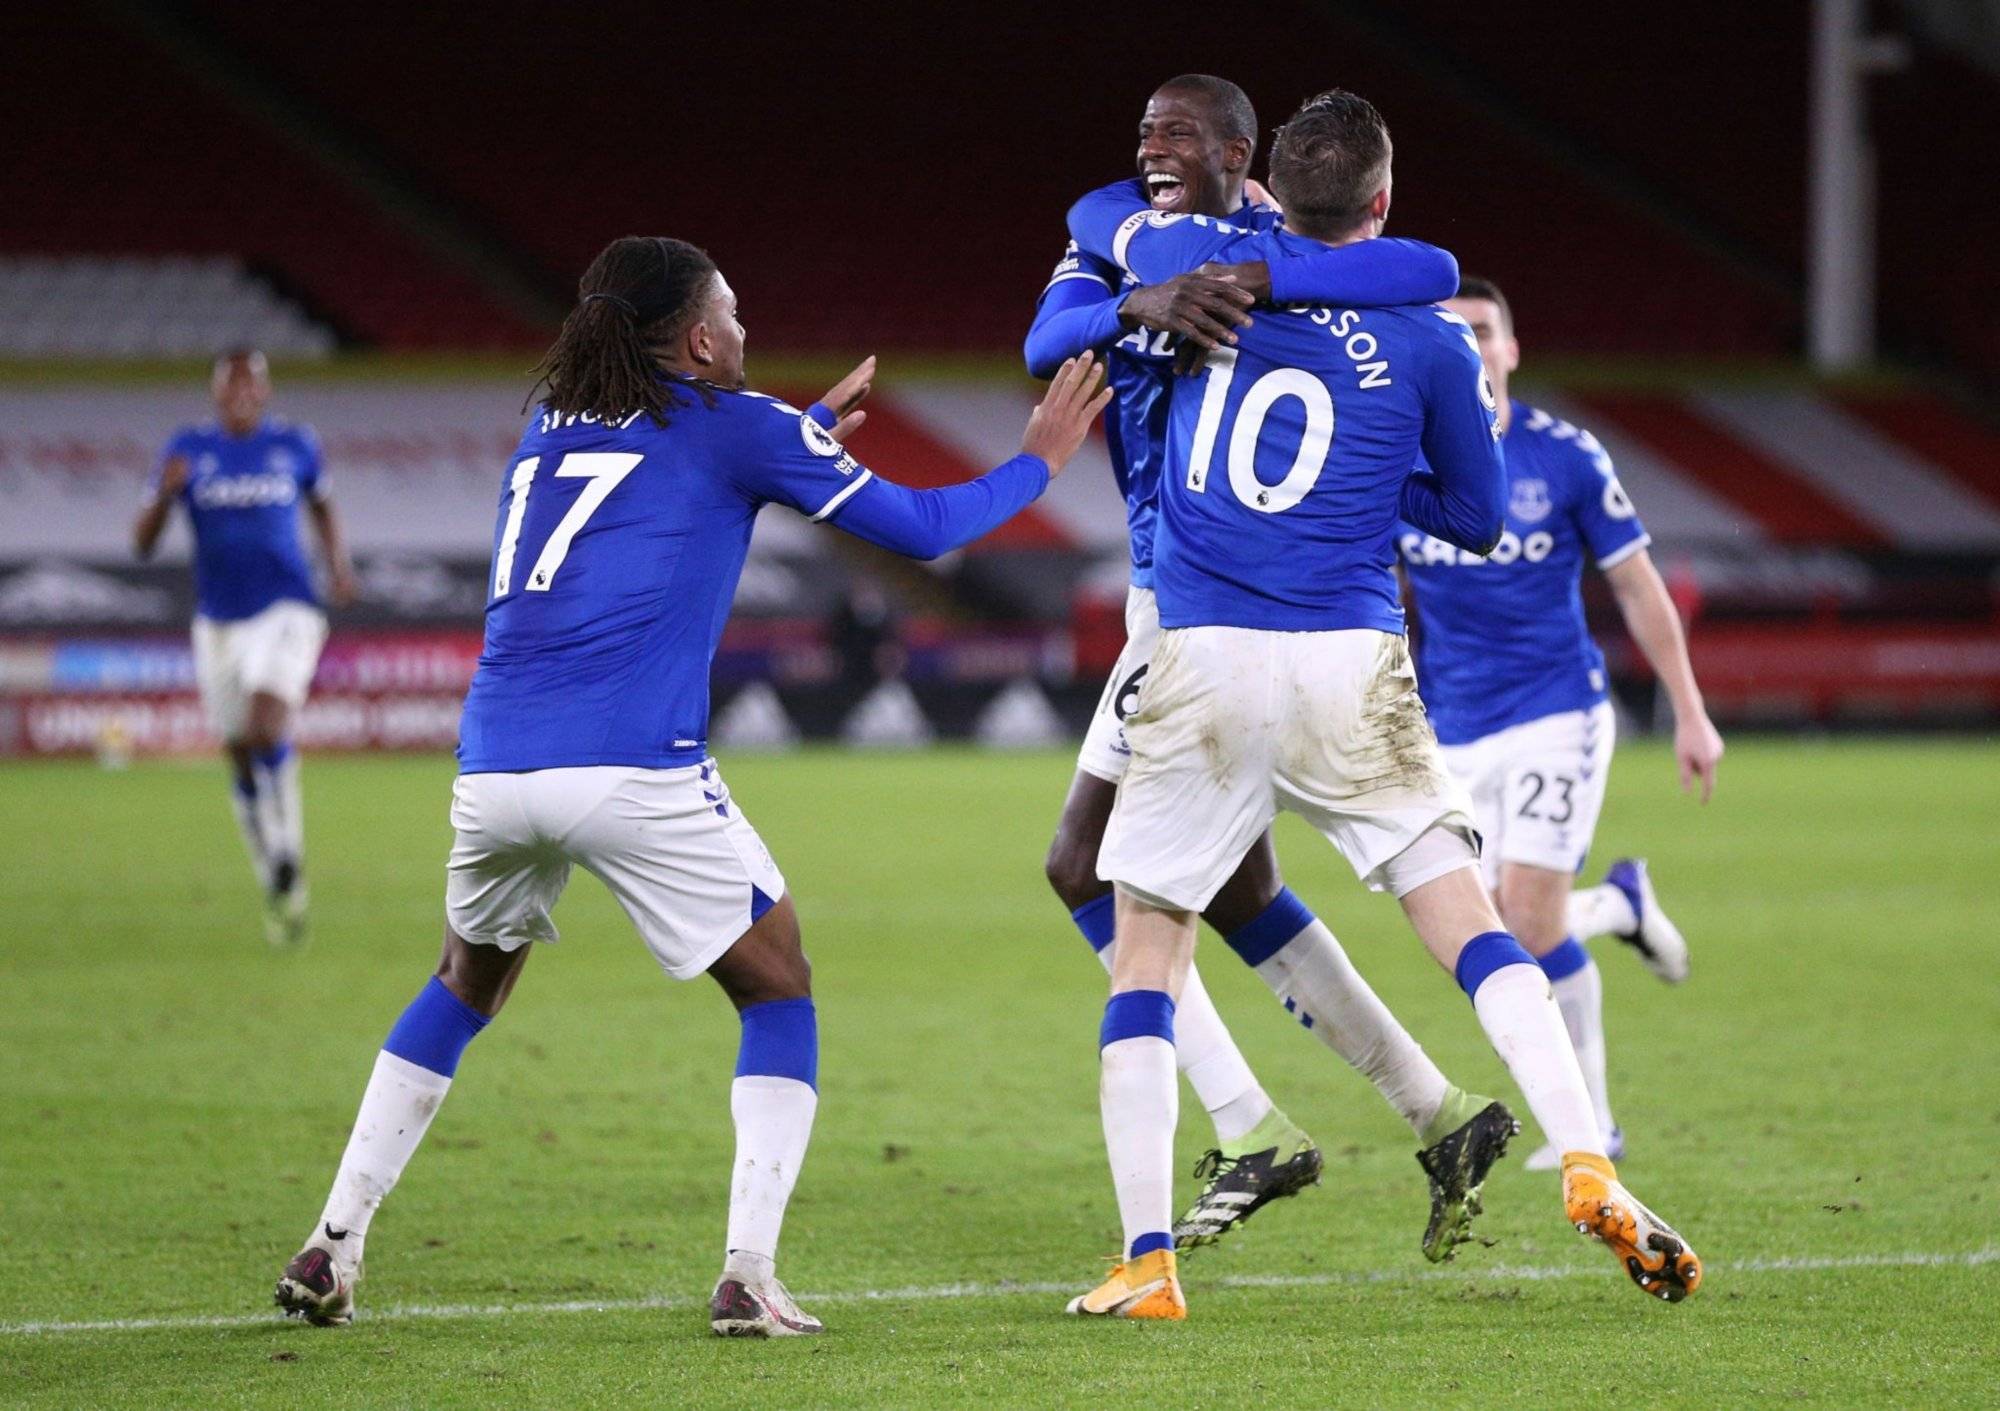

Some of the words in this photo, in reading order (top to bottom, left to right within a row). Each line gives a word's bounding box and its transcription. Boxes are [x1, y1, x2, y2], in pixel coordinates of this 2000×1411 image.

[1186, 344, 1334, 513] 10
[494, 452, 645, 599] 17
[1518, 772, 1574, 823] 23
